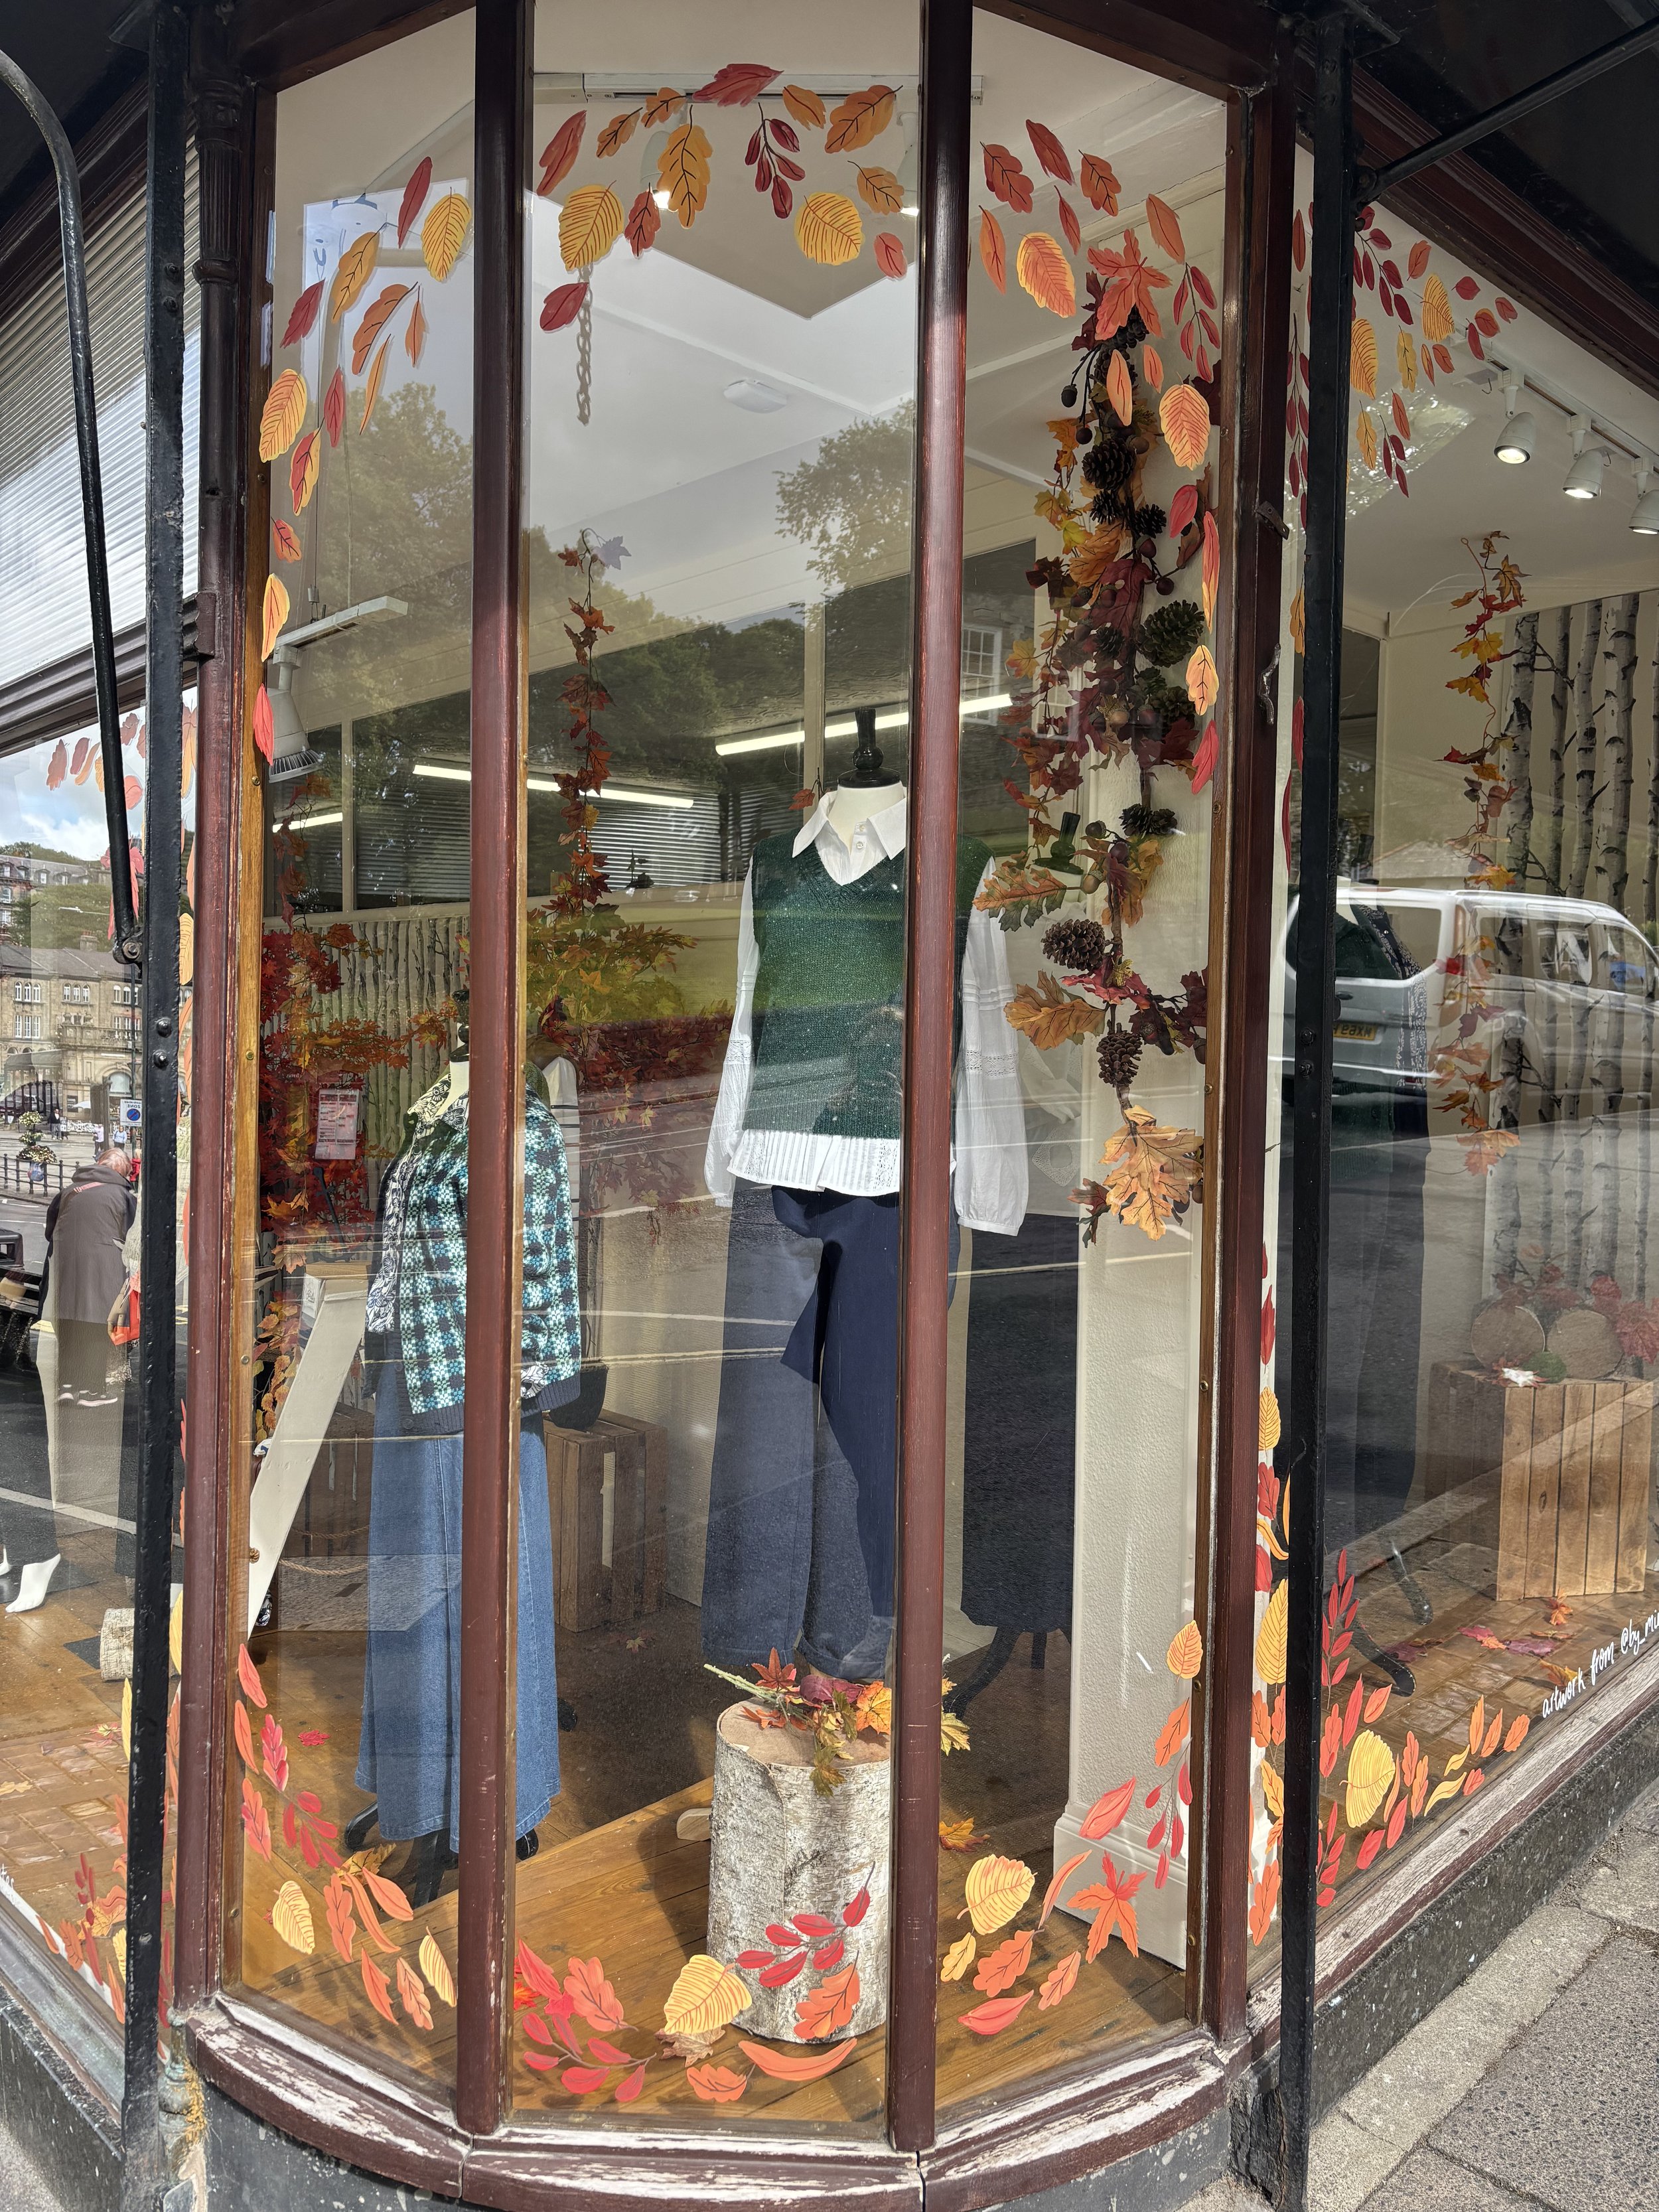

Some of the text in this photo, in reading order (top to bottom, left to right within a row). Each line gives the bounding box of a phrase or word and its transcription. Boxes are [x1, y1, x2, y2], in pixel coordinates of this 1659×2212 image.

[1542, 1609, 1659, 1718] artwork from @by_mi
